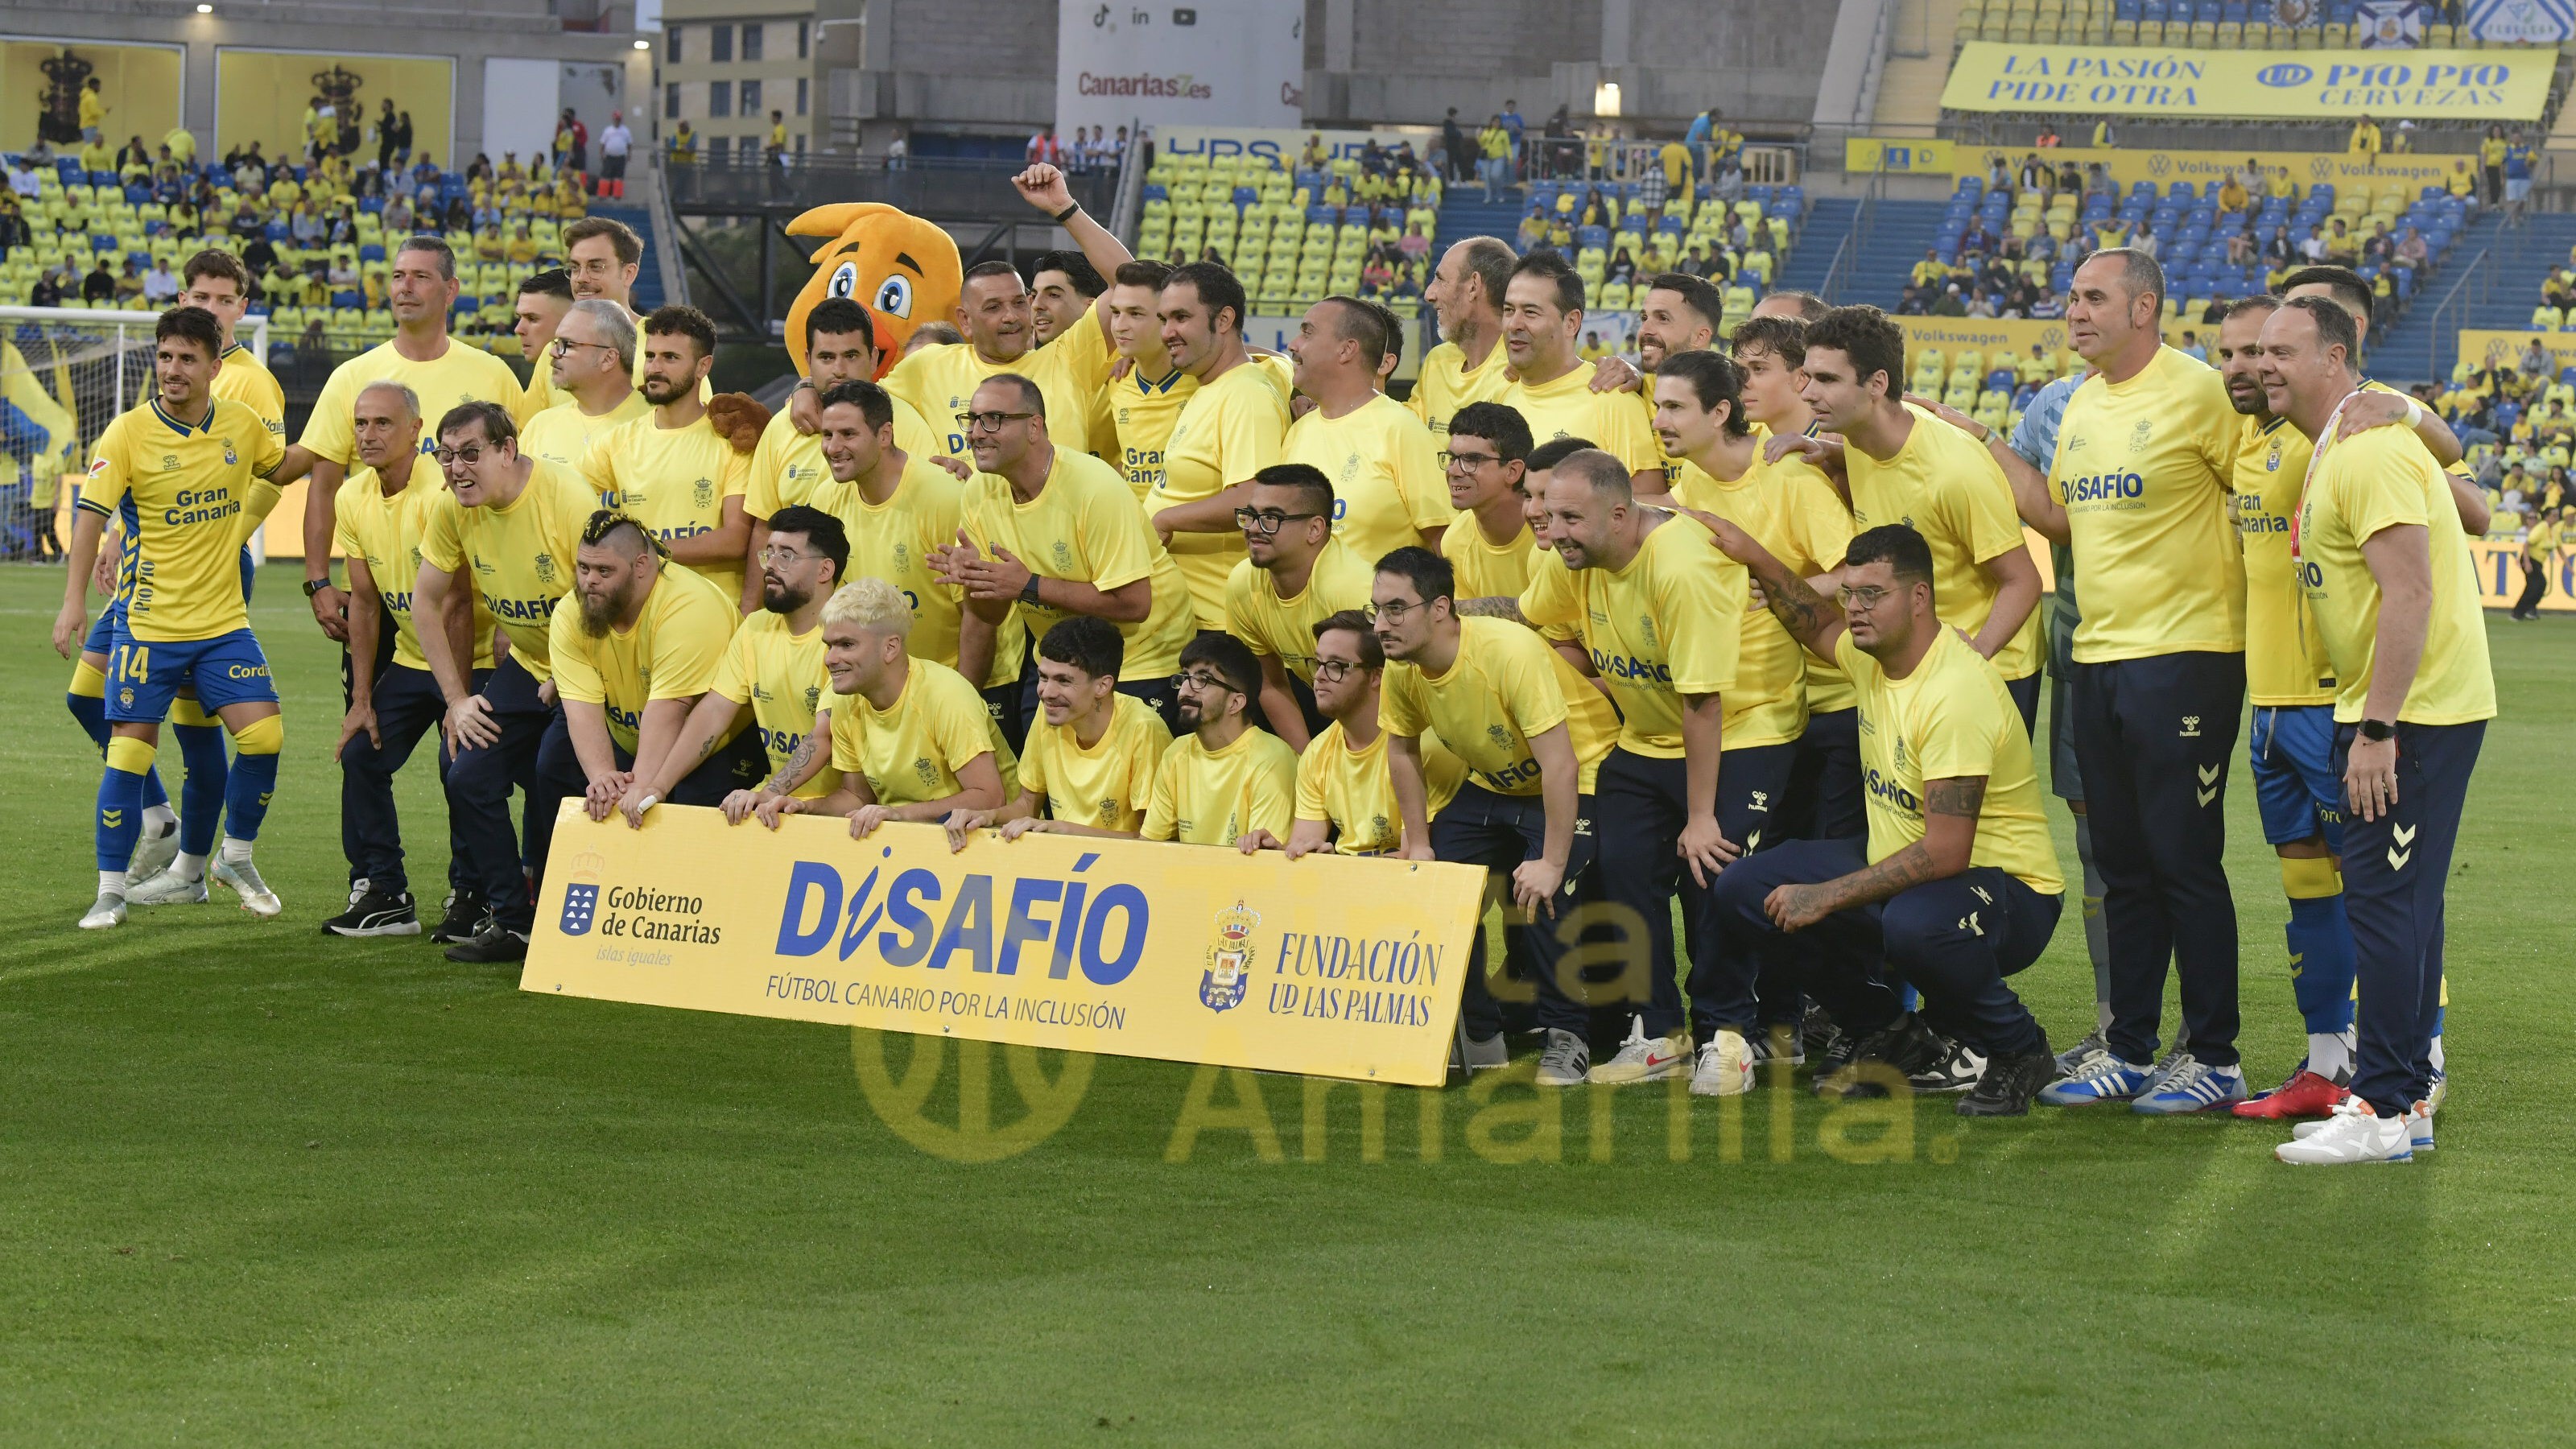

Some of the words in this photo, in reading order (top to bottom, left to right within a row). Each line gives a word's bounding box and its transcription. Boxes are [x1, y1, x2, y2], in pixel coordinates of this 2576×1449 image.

[2003, 56, 2050, 76] LA
[2065, 54, 2206, 80] PASIÓN
[1987, 80, 2077, 103] PIDE
[2089, 83, 2198, 106] OTRA
[2319, 89, 2506, 105] CERVEZAS
[2178, 160, 2277, 175] Volkswaen
[2339, 163, 2441, 178] Volkswagen
[1913, 328, 2008, 346] Volkswagen
[1125, 464, 1160, 483] Cana
[176, 487, 228, 506] Gran
[164, 499, 241, 526] Canaria
[2243, 512, 2289, 533] naria
[118, 644, 150, 684] 14
[607, 886, 703, 914] Gobierno
[601, 912, 625, 935] de
[631, 915, 721, 945] Canarias
[596, 944, 624, 963] islas
[627, 948, 672, 968] iguales
[1275, 930, 1444, 987] FUNDACIÓN
[766, 972, 839, 1004] FÚTBOL
[845, 981, 934, 1012] CANARIO
[939, 990, 980, 1017] POR
[985, 995, 1008, 1019] LA
[1014, 997, 1126, 1030] INCLUSIÓN
[1269, 982, 1299, 1014] UD
[1302, 987, 1340, 1020] LAS
[1344, 990, 1433, 1027] PALMAS
